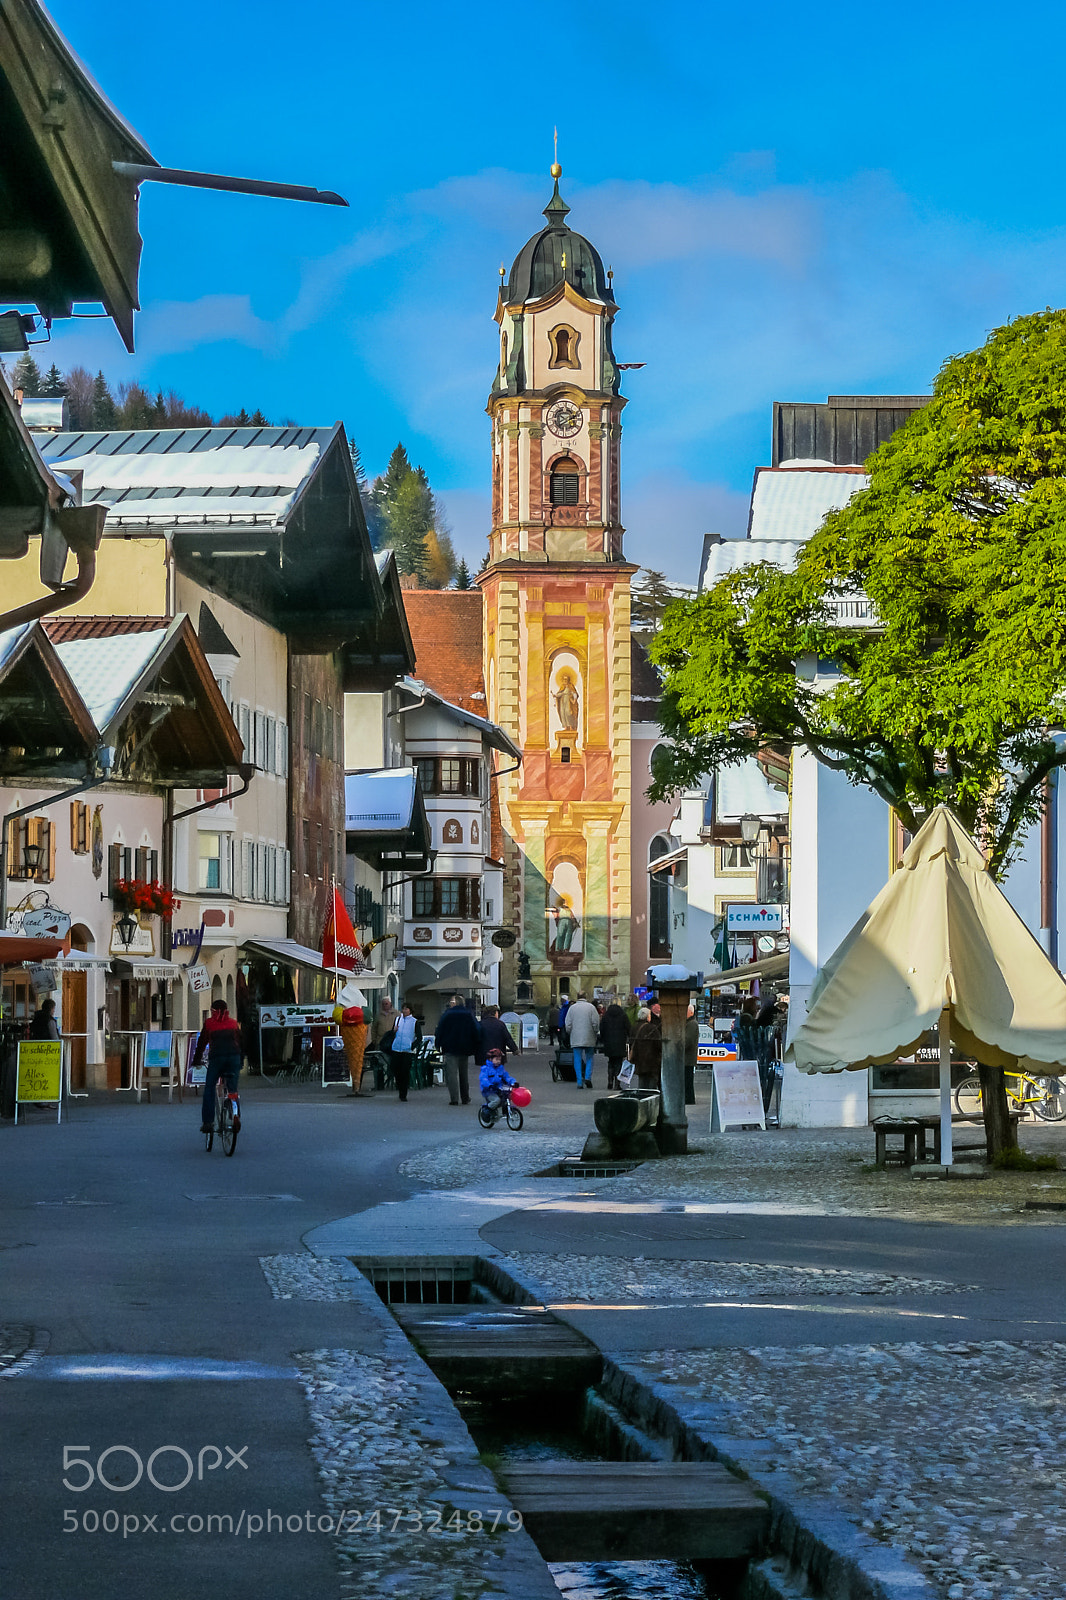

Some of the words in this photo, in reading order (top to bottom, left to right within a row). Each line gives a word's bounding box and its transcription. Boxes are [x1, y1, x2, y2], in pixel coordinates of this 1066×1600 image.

[43, 911, 68, 923] Pizza
[729, 913, 780, 921] SCHMIDT
[194, 979, 210, 991] Eis
[698, 1048, 726, 1057] Plus
[25, 1069, 45, 1079] Alles
[20, 1079, 49, 1092] -30%
